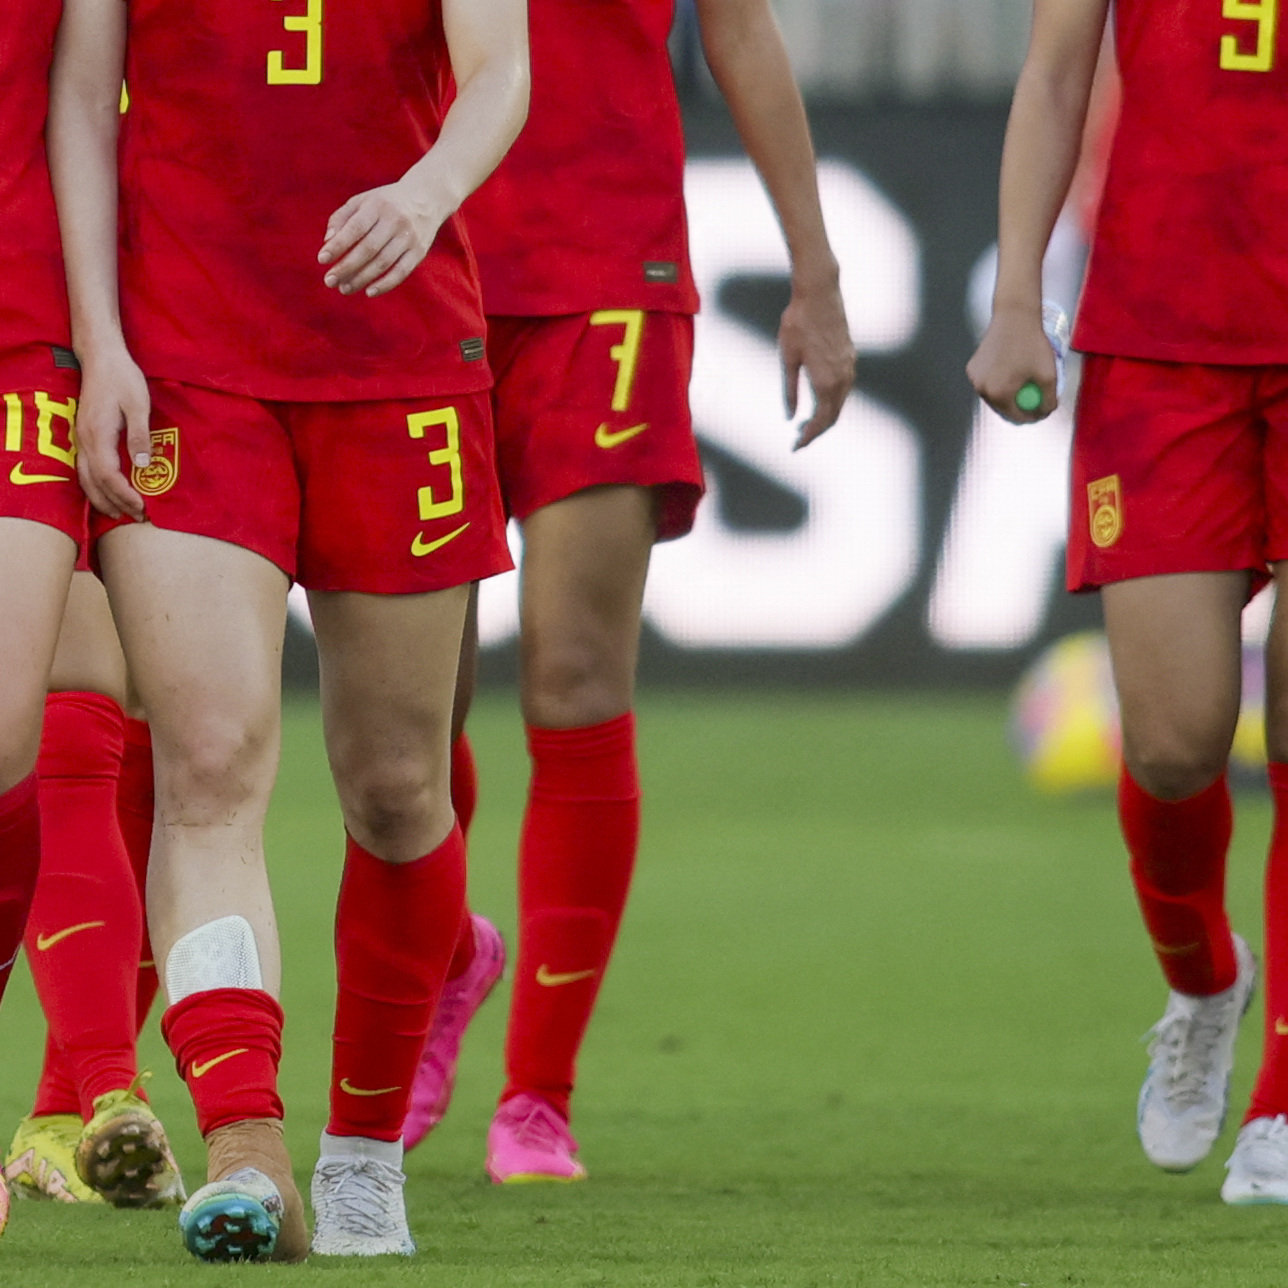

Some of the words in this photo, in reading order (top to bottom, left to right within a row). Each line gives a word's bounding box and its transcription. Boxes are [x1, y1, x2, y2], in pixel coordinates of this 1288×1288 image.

[589, 309, 644, 412] 7
[151, 433, 174, 447] FA
[406, 406, 464, 521] 3
